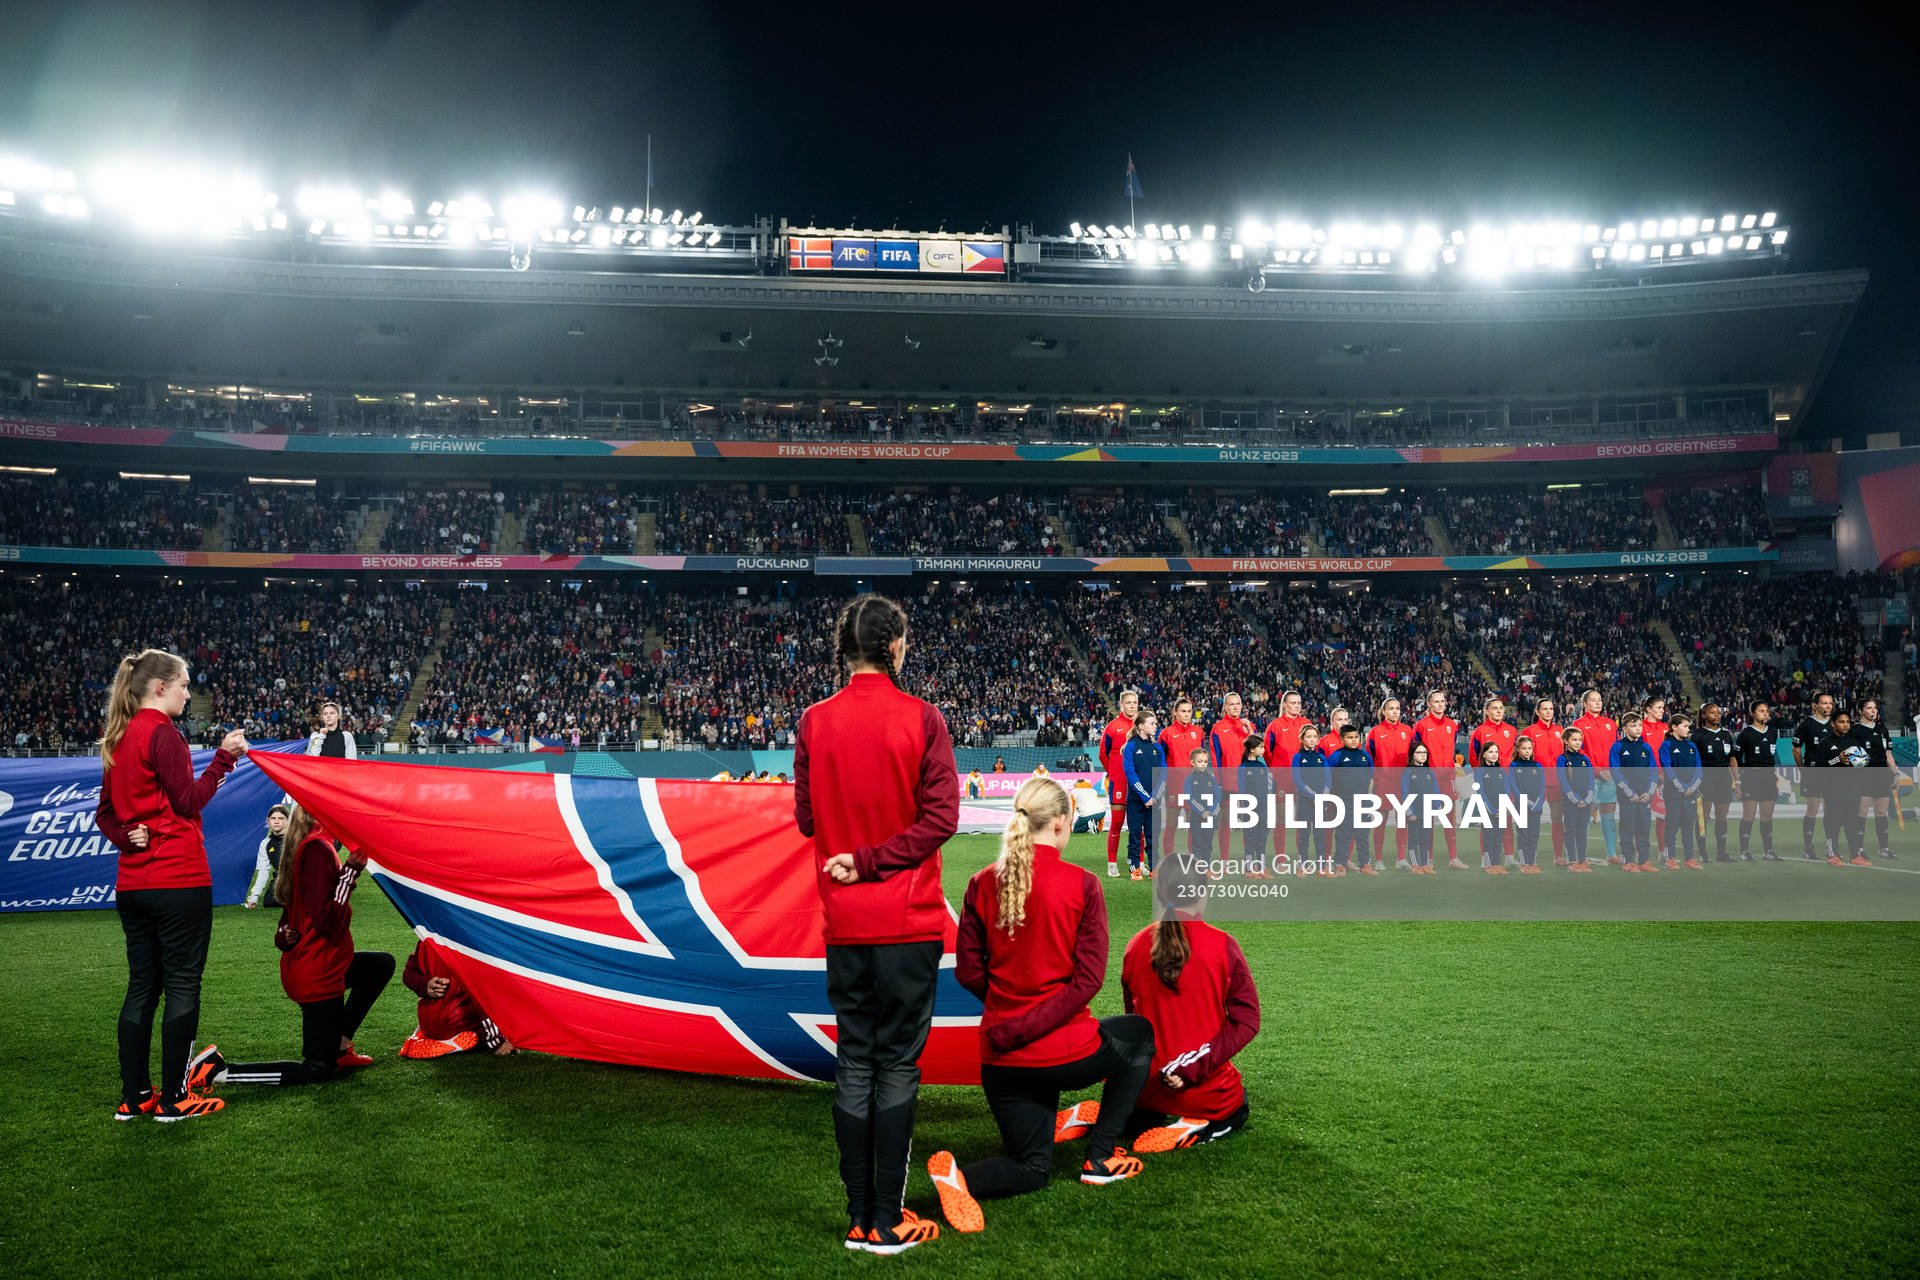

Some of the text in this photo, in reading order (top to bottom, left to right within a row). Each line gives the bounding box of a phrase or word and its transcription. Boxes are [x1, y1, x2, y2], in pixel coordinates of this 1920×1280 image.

[837, 247, 869, 262] AFC
[882, 250, 912, 261] FIFA
[0, 422, 57, 437] TNESS
[409, 440, 485, 452] #FIFAWWC
[778, 445, 951, 457] FIFA WOMEN'S WORLD CUP
[1597, 439, 1737, 457] BEYOND GREATNESS
[362, 557, 418, 567] BEYOND
[736, 558, 809, 569] AUCKLAND
[916, 557, 1041, 570] TĀMAKI MAKAURAU
[1232, 560, 1392, 570] FIFA WOMEN'S WORLD CUP
[24, 810, 101, 835] GEN
[8, 835, 120, 861] EQUAL
[71, 884, 110, 896] UN
[0, 894, 105, 908] WOMEN
